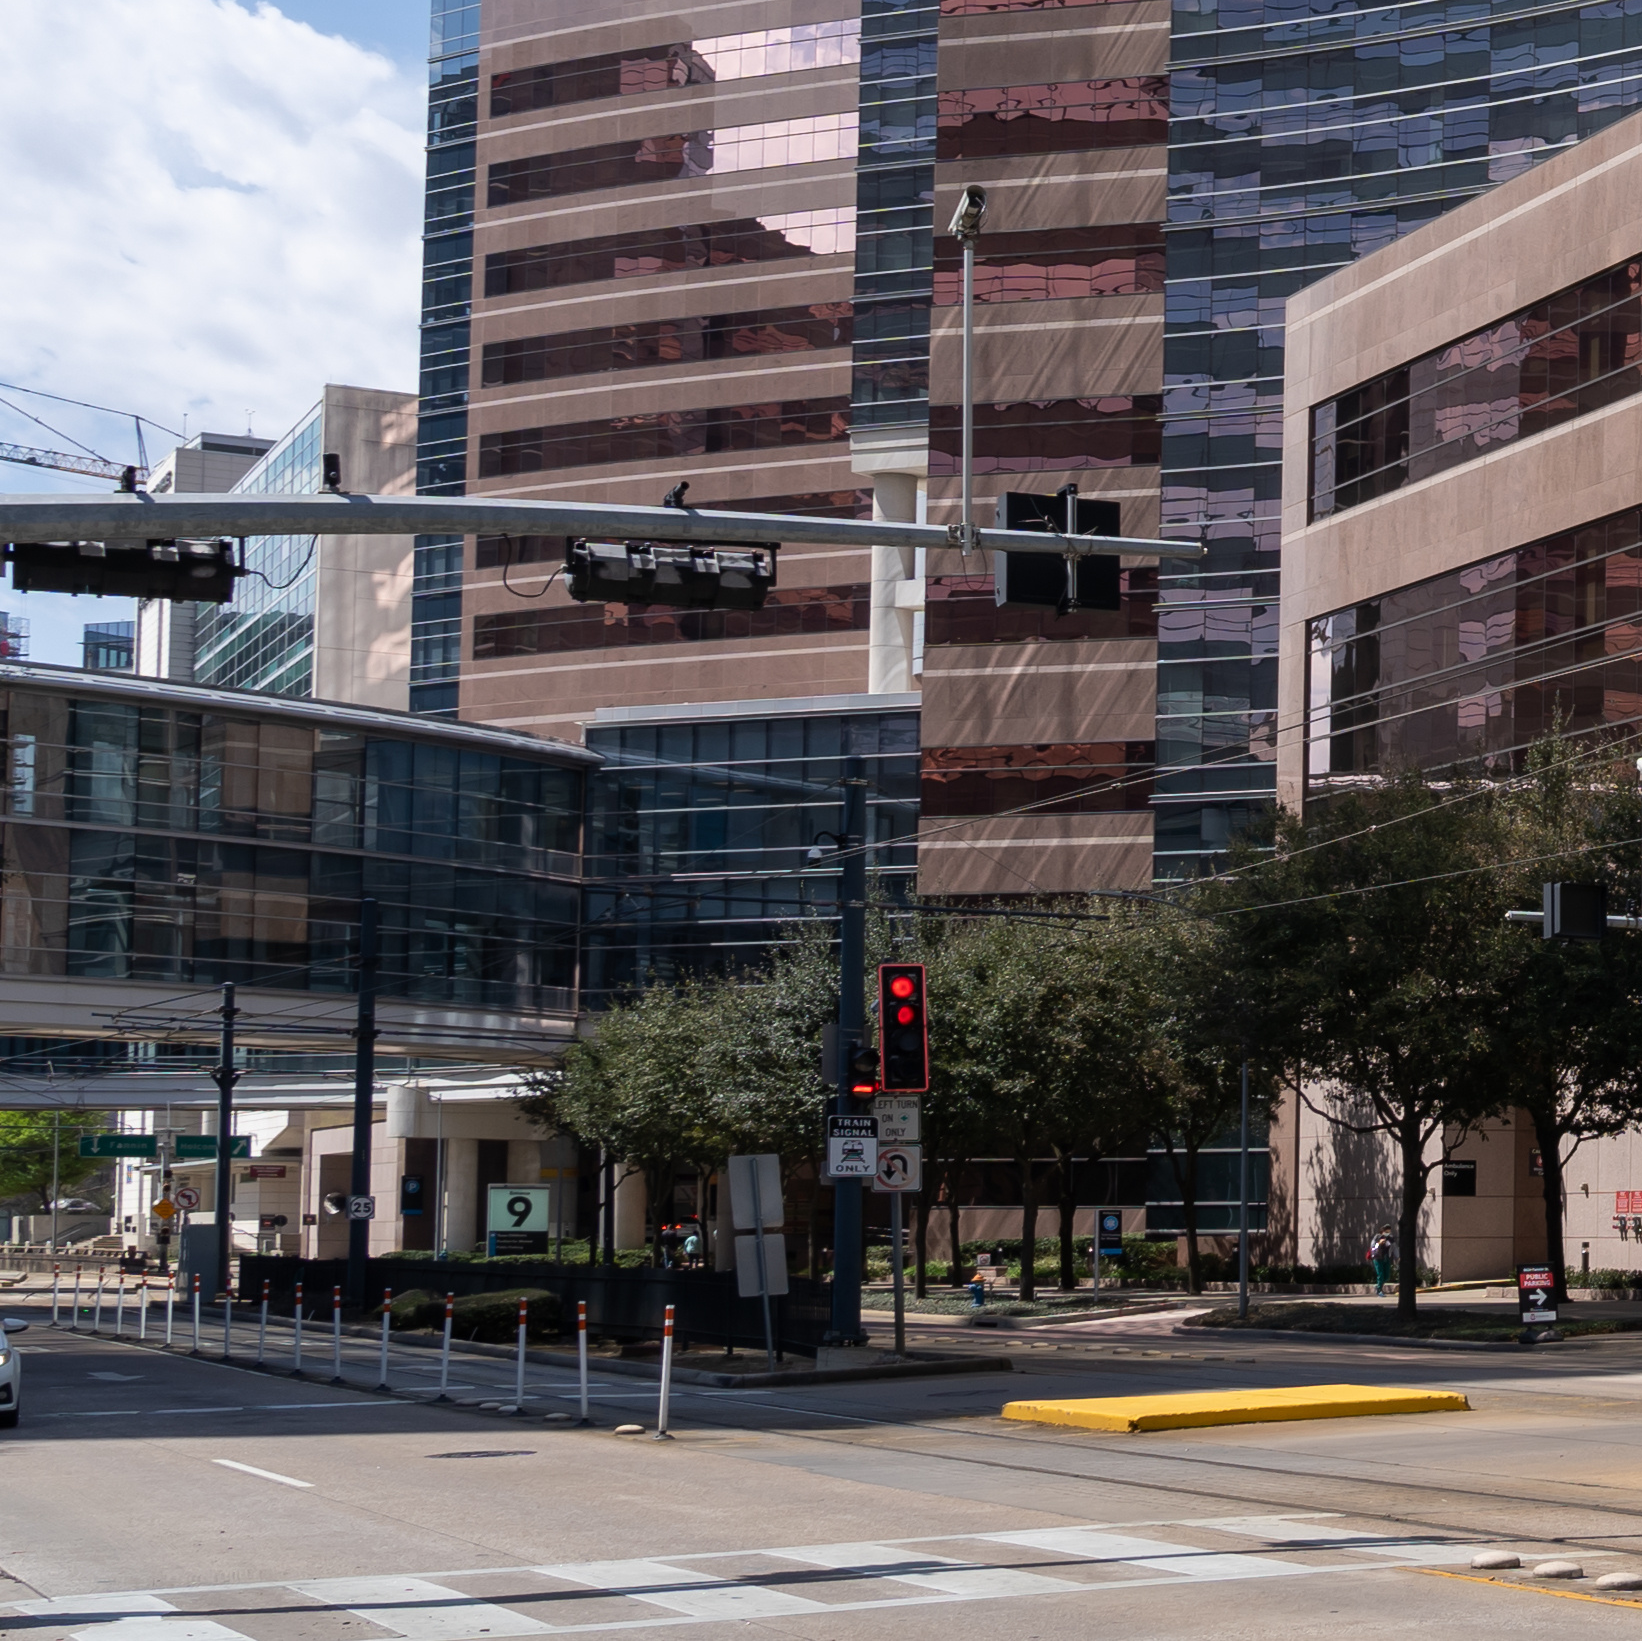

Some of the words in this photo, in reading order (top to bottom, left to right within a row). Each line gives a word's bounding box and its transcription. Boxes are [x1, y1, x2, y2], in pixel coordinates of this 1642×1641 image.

[874, 1100, 893, 1109] LEFT
[897, 1100, 918, 1109] TURN
[838, 1119, 871, 1127] TRAIN
[882, 1114, 893, 1123] ON
[833, 1128, 874, 1137] SIGNAL
[885, 1128, 906, 1137] ONLY
[1444, 1170, 1458, 1178] Only
[353, 1202, 372, 1213] 25
[506, 1196, 533, 1228] 9
